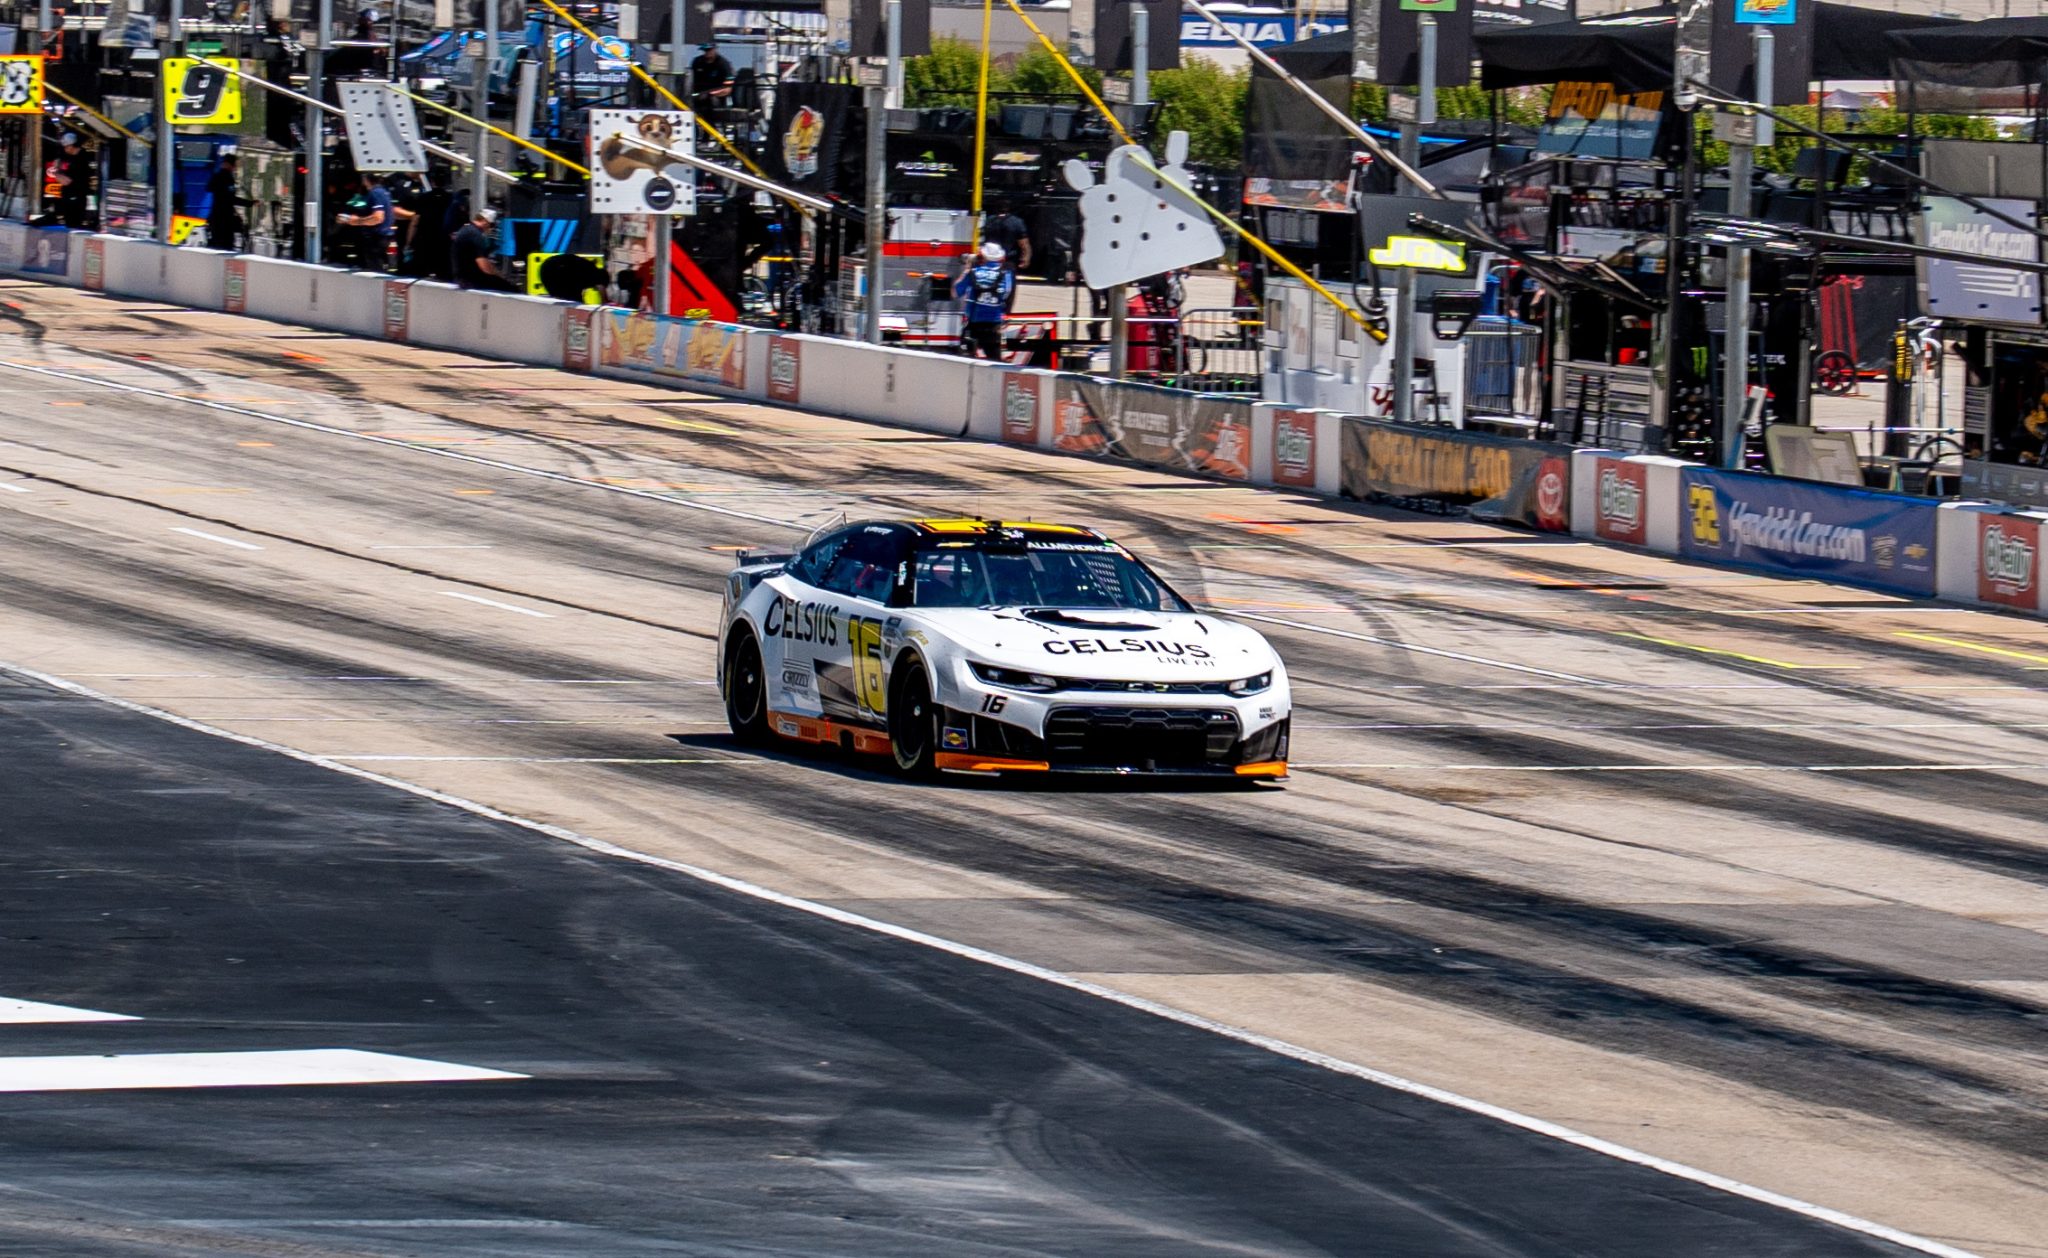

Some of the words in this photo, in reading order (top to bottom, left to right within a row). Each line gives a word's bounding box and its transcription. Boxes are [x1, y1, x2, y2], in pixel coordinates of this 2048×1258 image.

[175, 64, 226, 118] 9
[764, 596, 840, 647] CELSIUS
[848, 614, 888, 714] 16
[1043, 638, 1211, 659] CELSIUS
[982, 693, 1008, 713] 16
